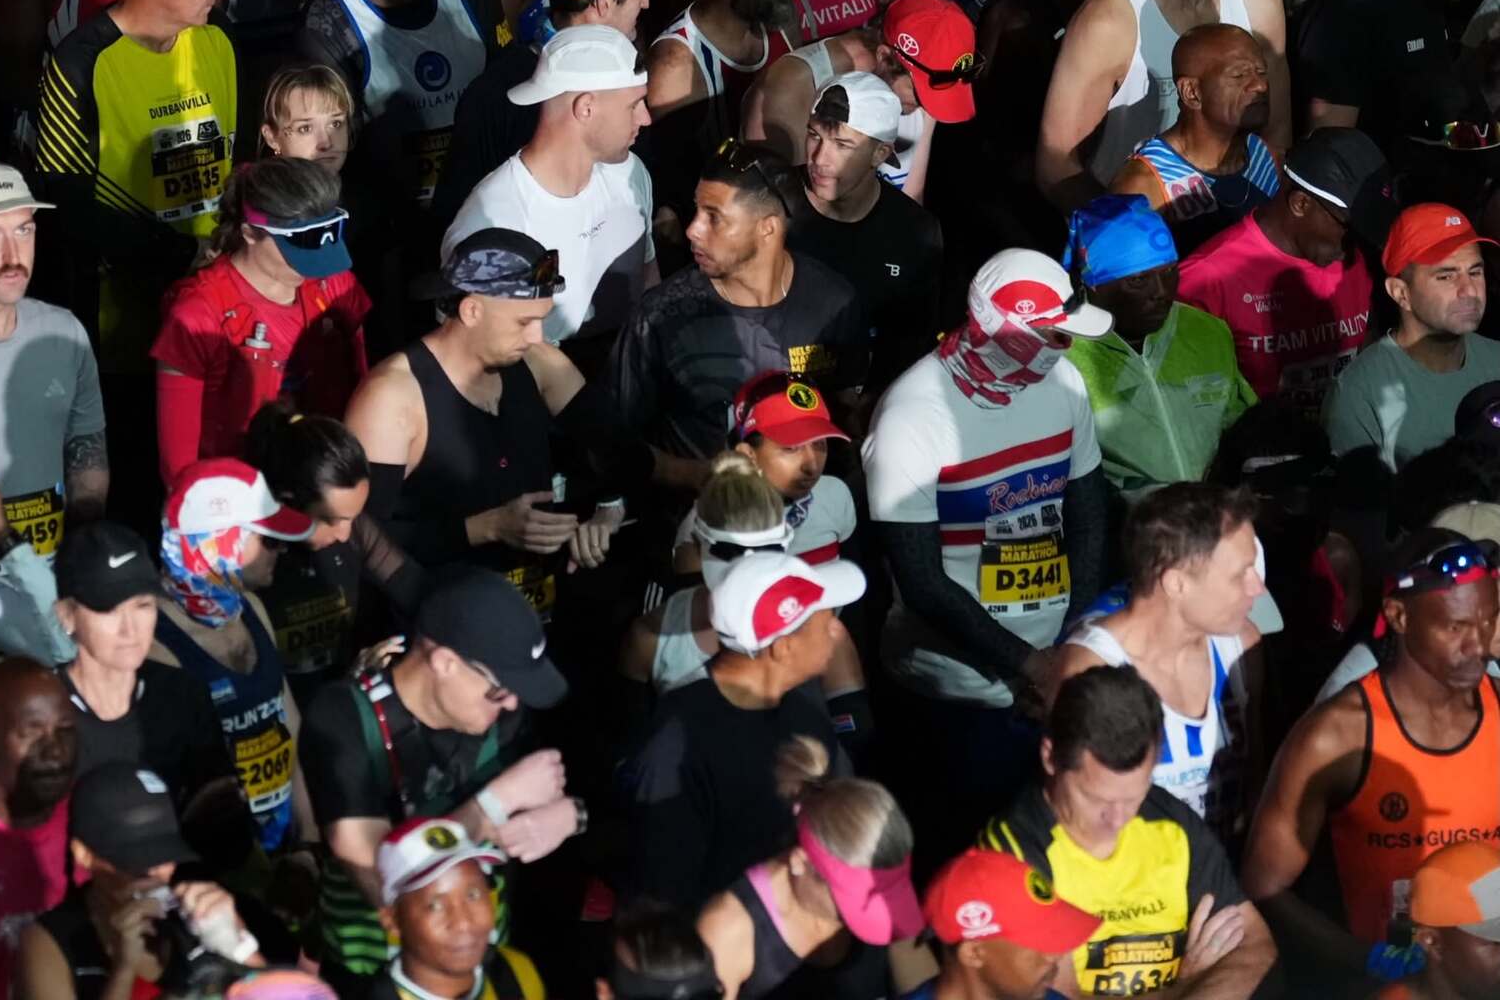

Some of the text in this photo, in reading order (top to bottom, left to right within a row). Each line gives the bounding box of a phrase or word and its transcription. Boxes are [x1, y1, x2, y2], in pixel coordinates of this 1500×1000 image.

[1249, 311, 1370, 354] TEAM VITALITY
[6, 502, 51, 521] RATHON
[1018, 513, 1038, 531] 2026
[1001, 549, 1059, 564] MARATHON
[996, 564, 1062, 592] D3441
